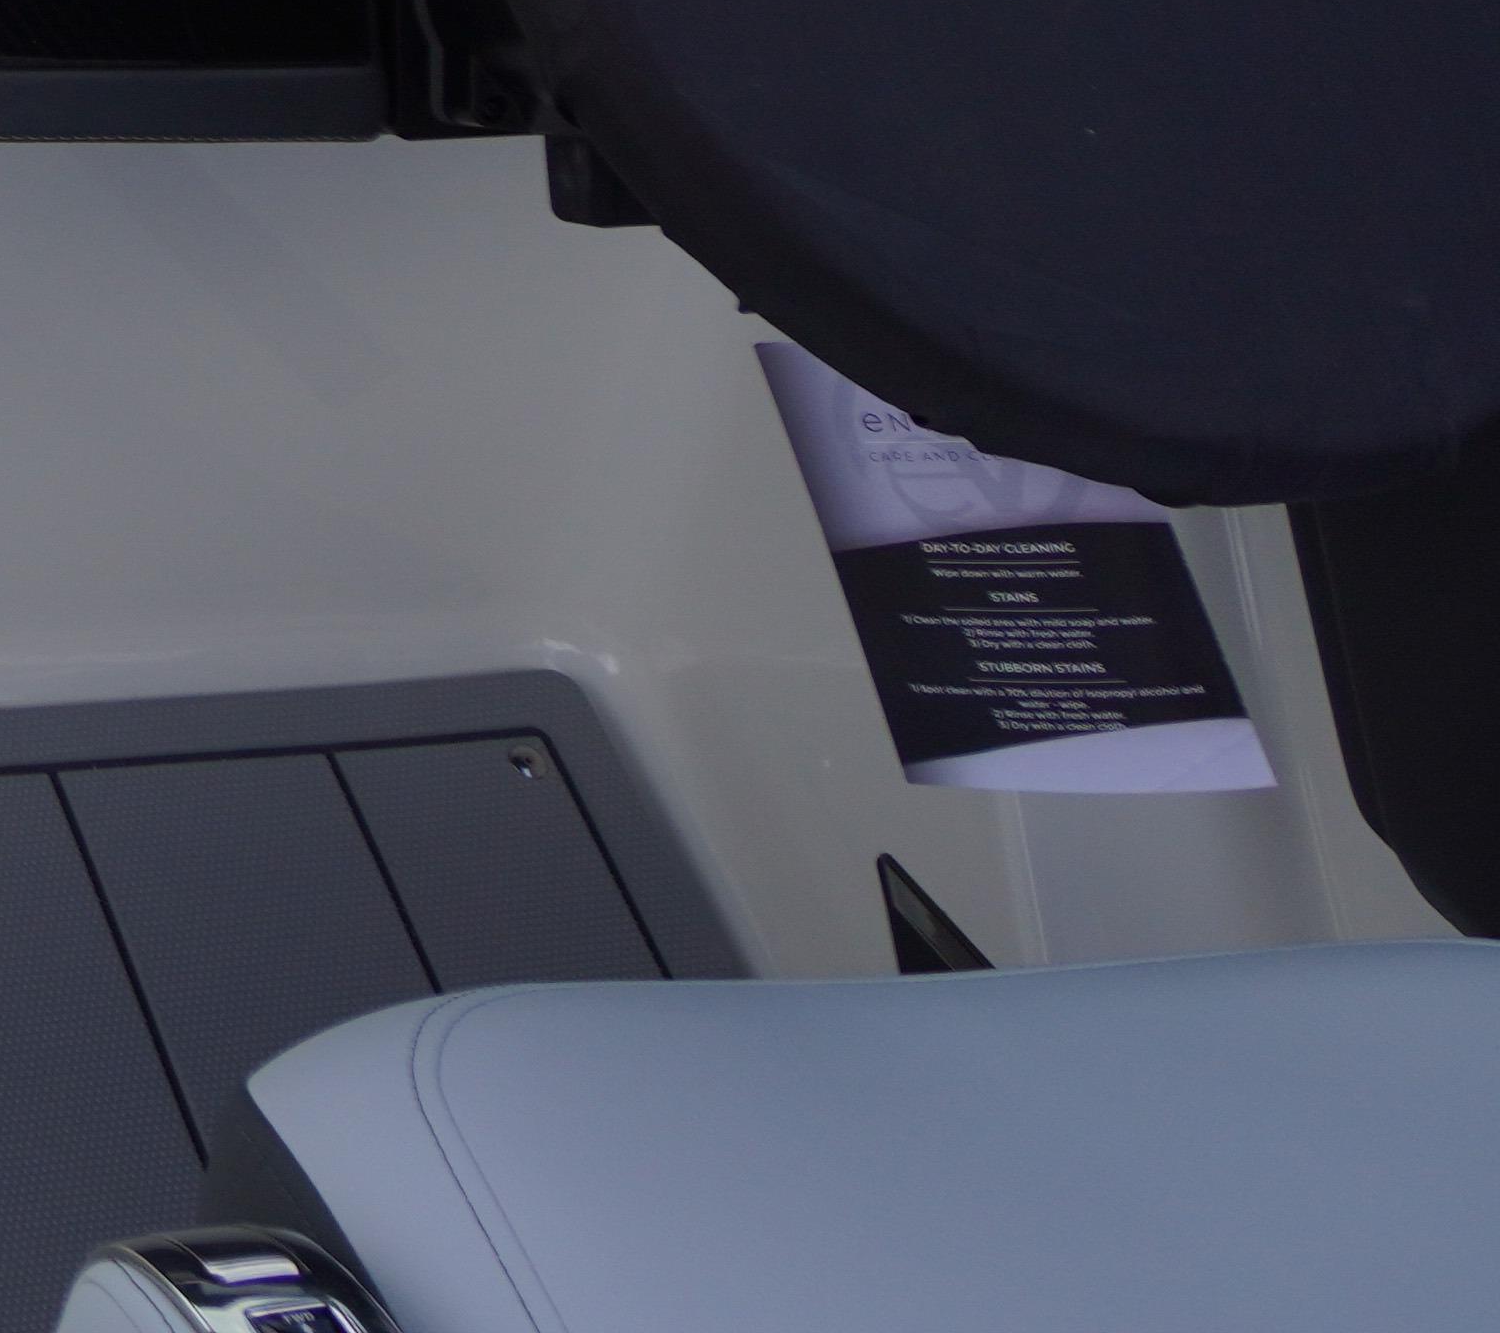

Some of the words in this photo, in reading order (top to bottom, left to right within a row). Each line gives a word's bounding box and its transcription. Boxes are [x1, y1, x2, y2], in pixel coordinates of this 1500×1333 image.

[869, 452, 915, 462] CARE
[924, 452, 959, 462] AND
[921, 543, 1000, 553] DAY-TO-DAY
[1002, 543, 1077, 553] CLEANING
[989, 592, 1040, 604] STAINS
[975, 661, 1052, 672] STUBBORN
[1054, 663, 1107, 673] STAINS
